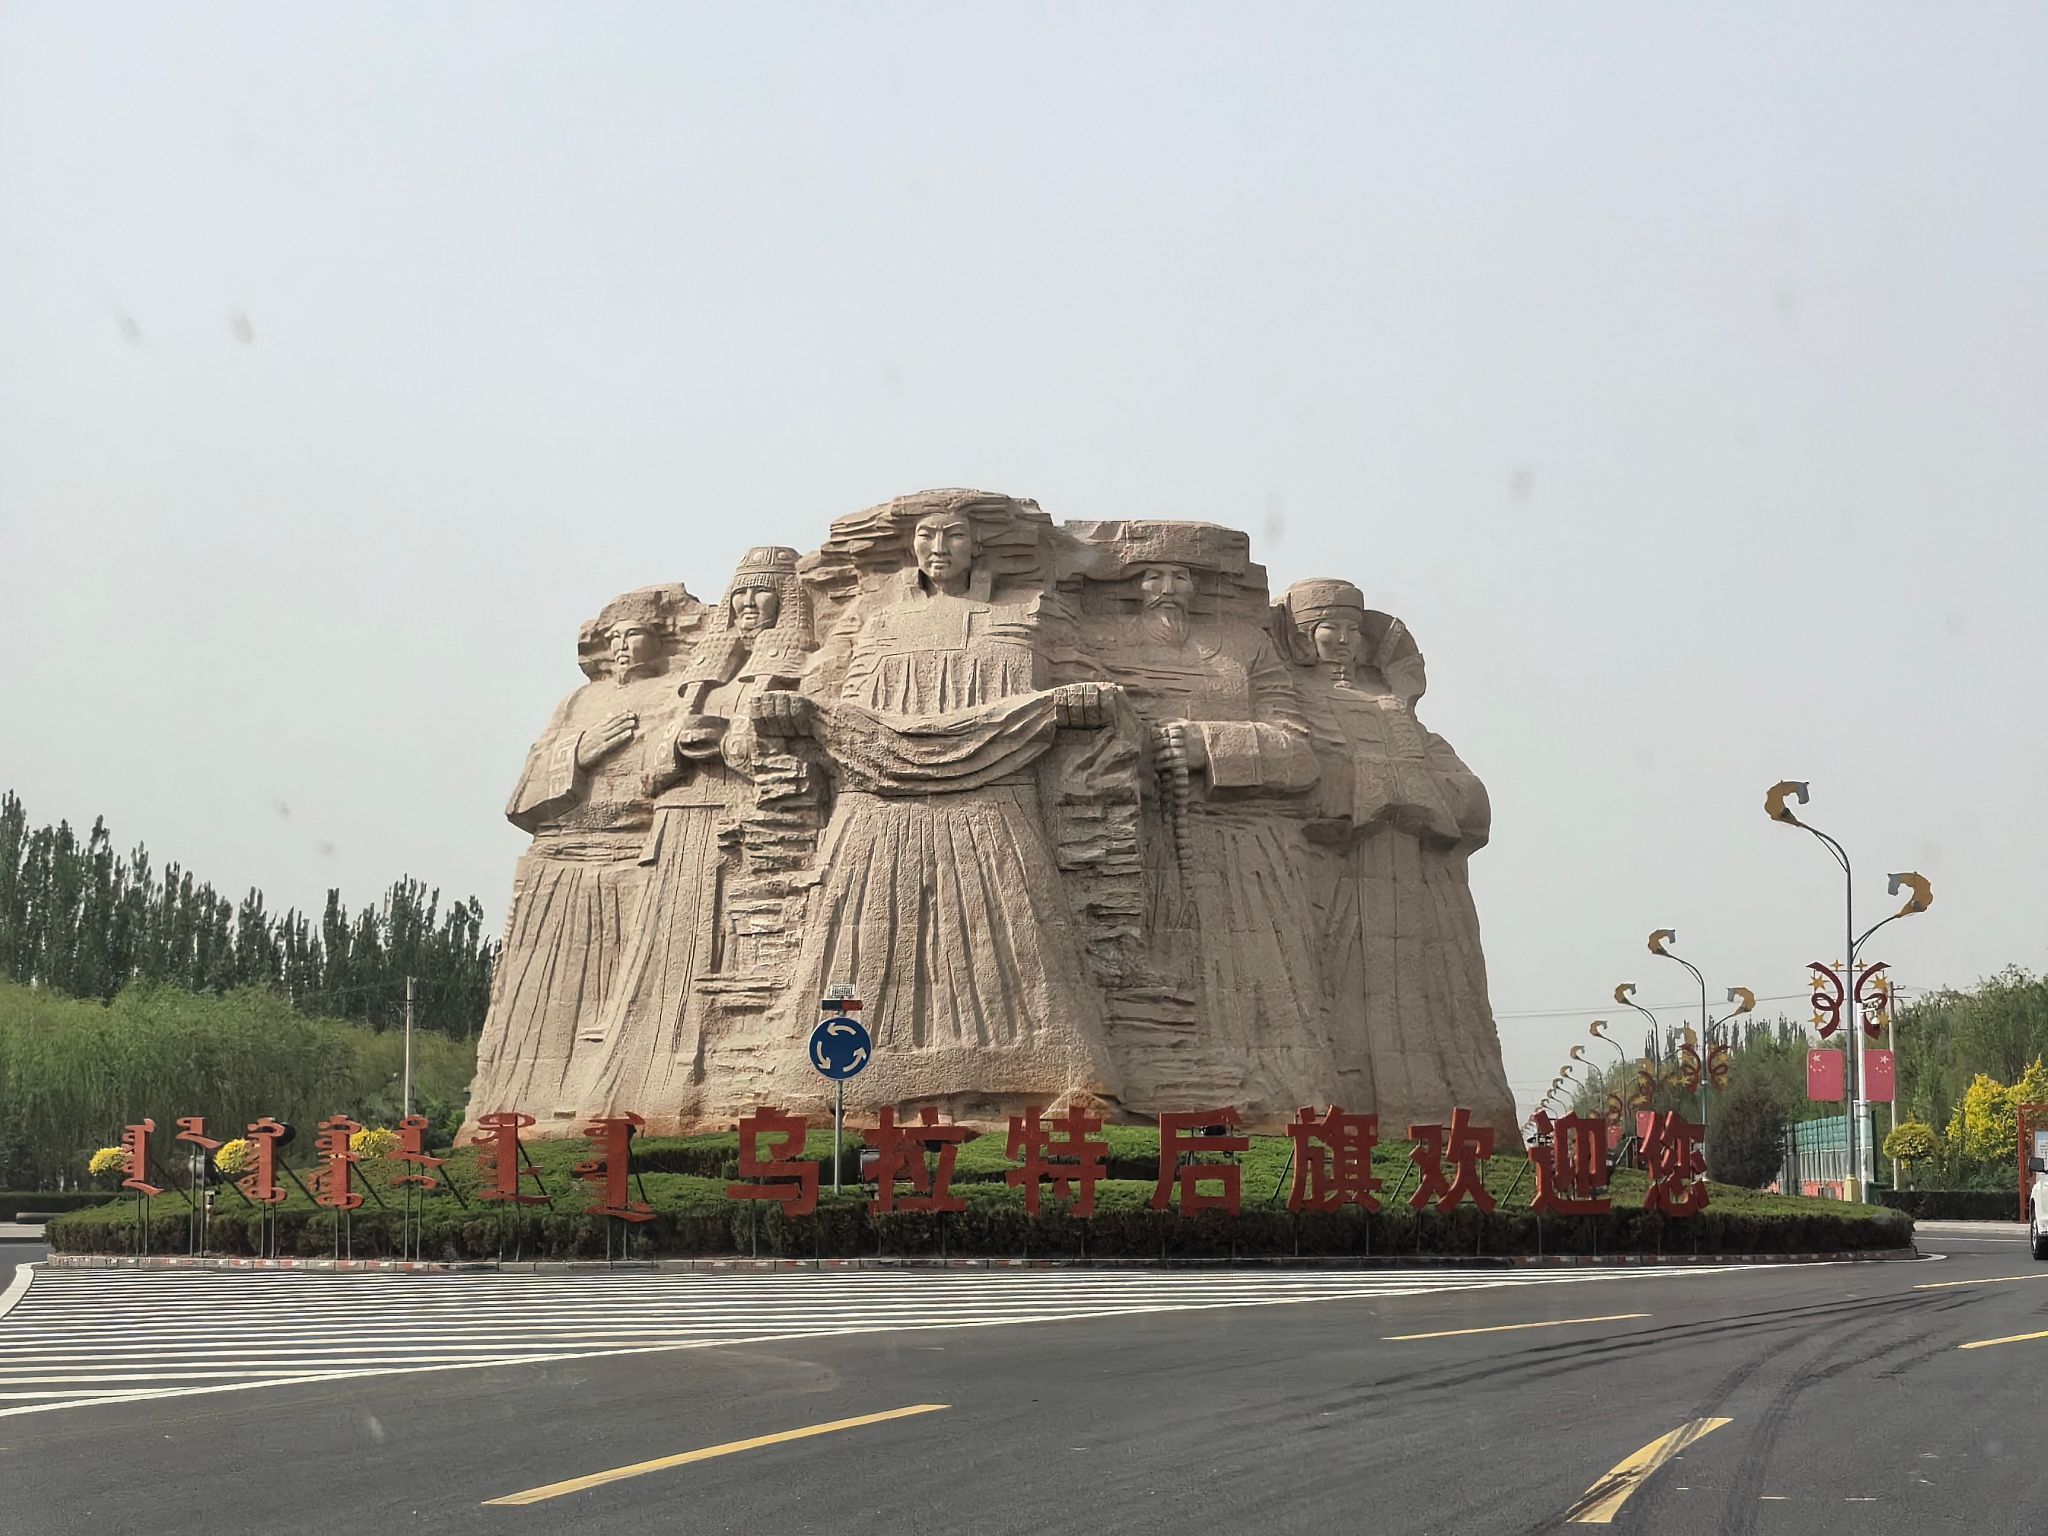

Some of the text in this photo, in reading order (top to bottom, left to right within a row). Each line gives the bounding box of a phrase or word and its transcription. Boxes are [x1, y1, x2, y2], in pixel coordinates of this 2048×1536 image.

[727, 1104, 1710, 1218] 乌拉特后旗欢迎您
